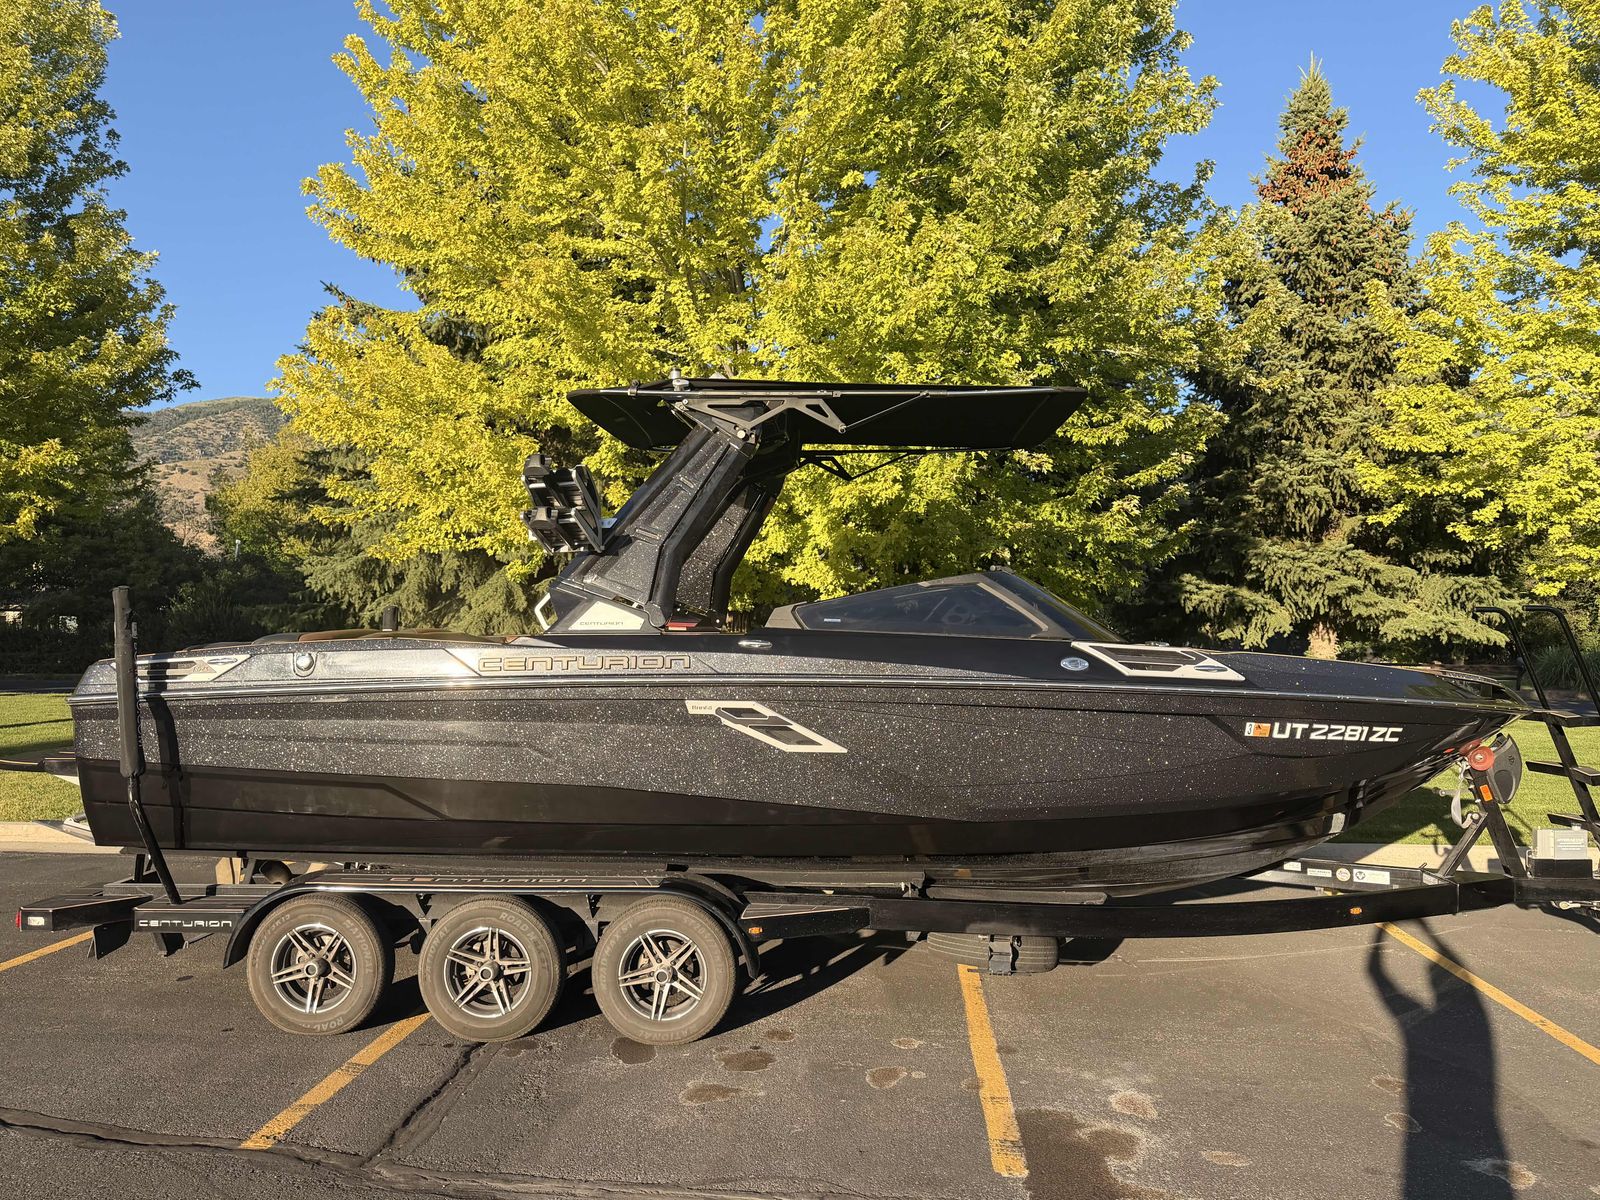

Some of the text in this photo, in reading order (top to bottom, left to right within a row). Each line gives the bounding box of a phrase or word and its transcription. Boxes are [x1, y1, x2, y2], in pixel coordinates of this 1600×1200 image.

[478, 655, 692, 673] CENTURION
[1272, 722, 1403, 742] UT 2281 ZC
[138, 920, 232, 928] CENTURION
[499, 911, 530, 932] ROAD
